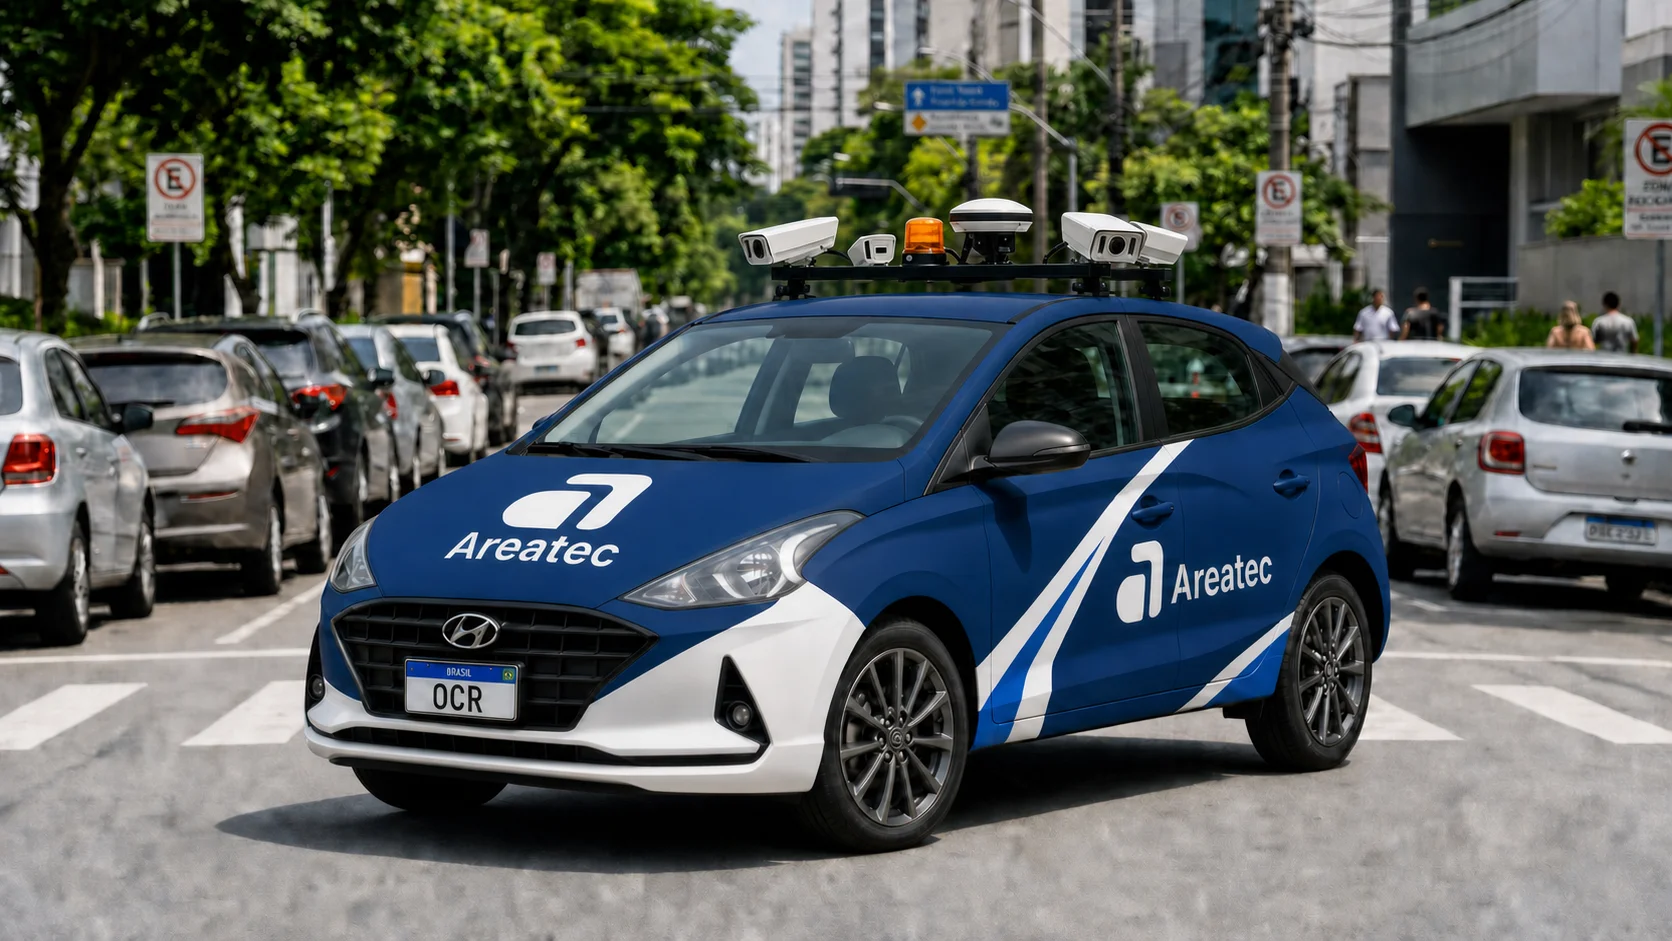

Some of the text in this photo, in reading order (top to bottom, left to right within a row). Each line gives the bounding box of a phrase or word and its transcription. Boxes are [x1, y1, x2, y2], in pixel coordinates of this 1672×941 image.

[1652, 134, 1672, 164] E
[167, 166, 183, 190] E
[444, 531, 620, 567] Areatec
[1171, 555, 1273, 604] Areatec
[446, 667, 472, 678] BRASIL
[433, 683, 483, 713] OCR
